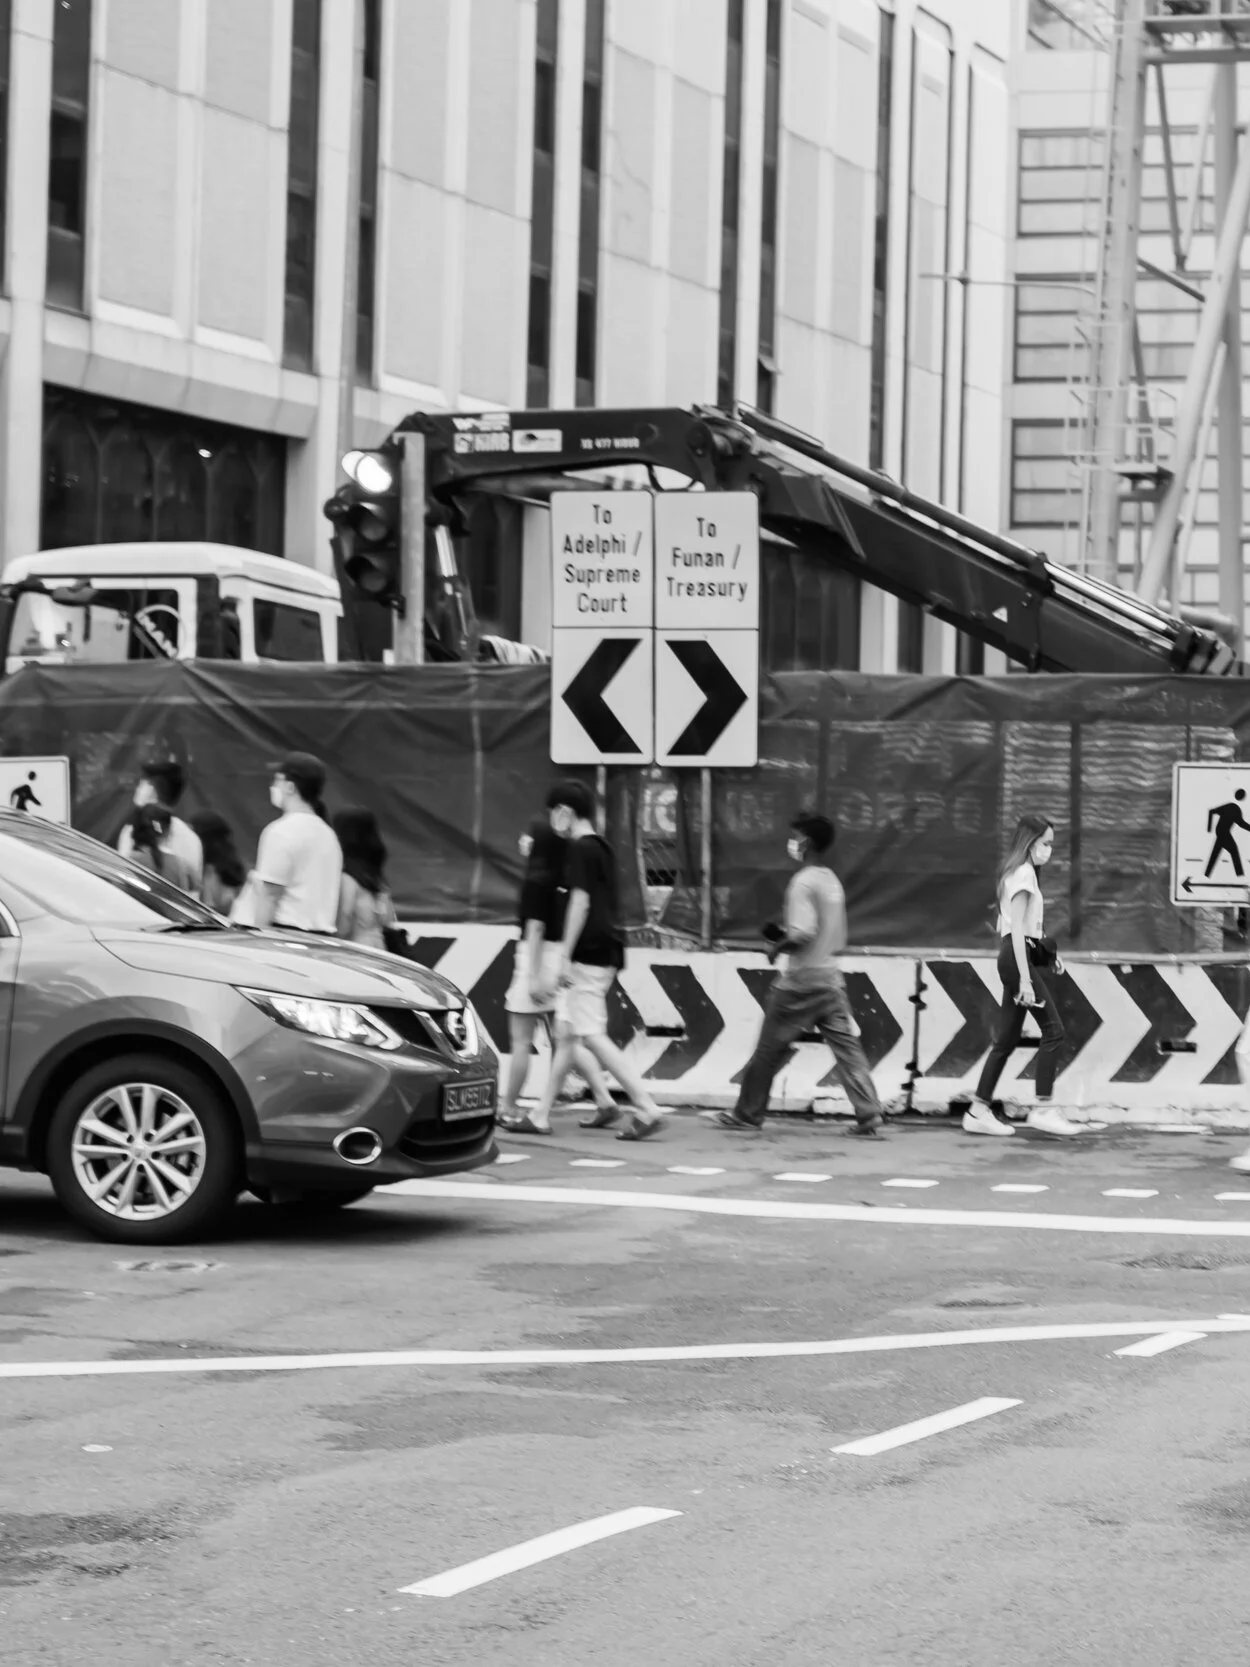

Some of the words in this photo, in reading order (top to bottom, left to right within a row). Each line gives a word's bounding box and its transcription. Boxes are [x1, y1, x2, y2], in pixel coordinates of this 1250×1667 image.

[592, 504, 612, 524] To
[696, 517, 717, 538] To
[563, 534, 626, 559] Adelphi
[632, 531, 642, 556] /
[671, 547, 725, 568] Funan
[731, 544, 741, 570] /
[564, 564, 641, 588] Supreme
[666, 577, 748, 602] Treasury
[577, 593, 628, 613] Court
